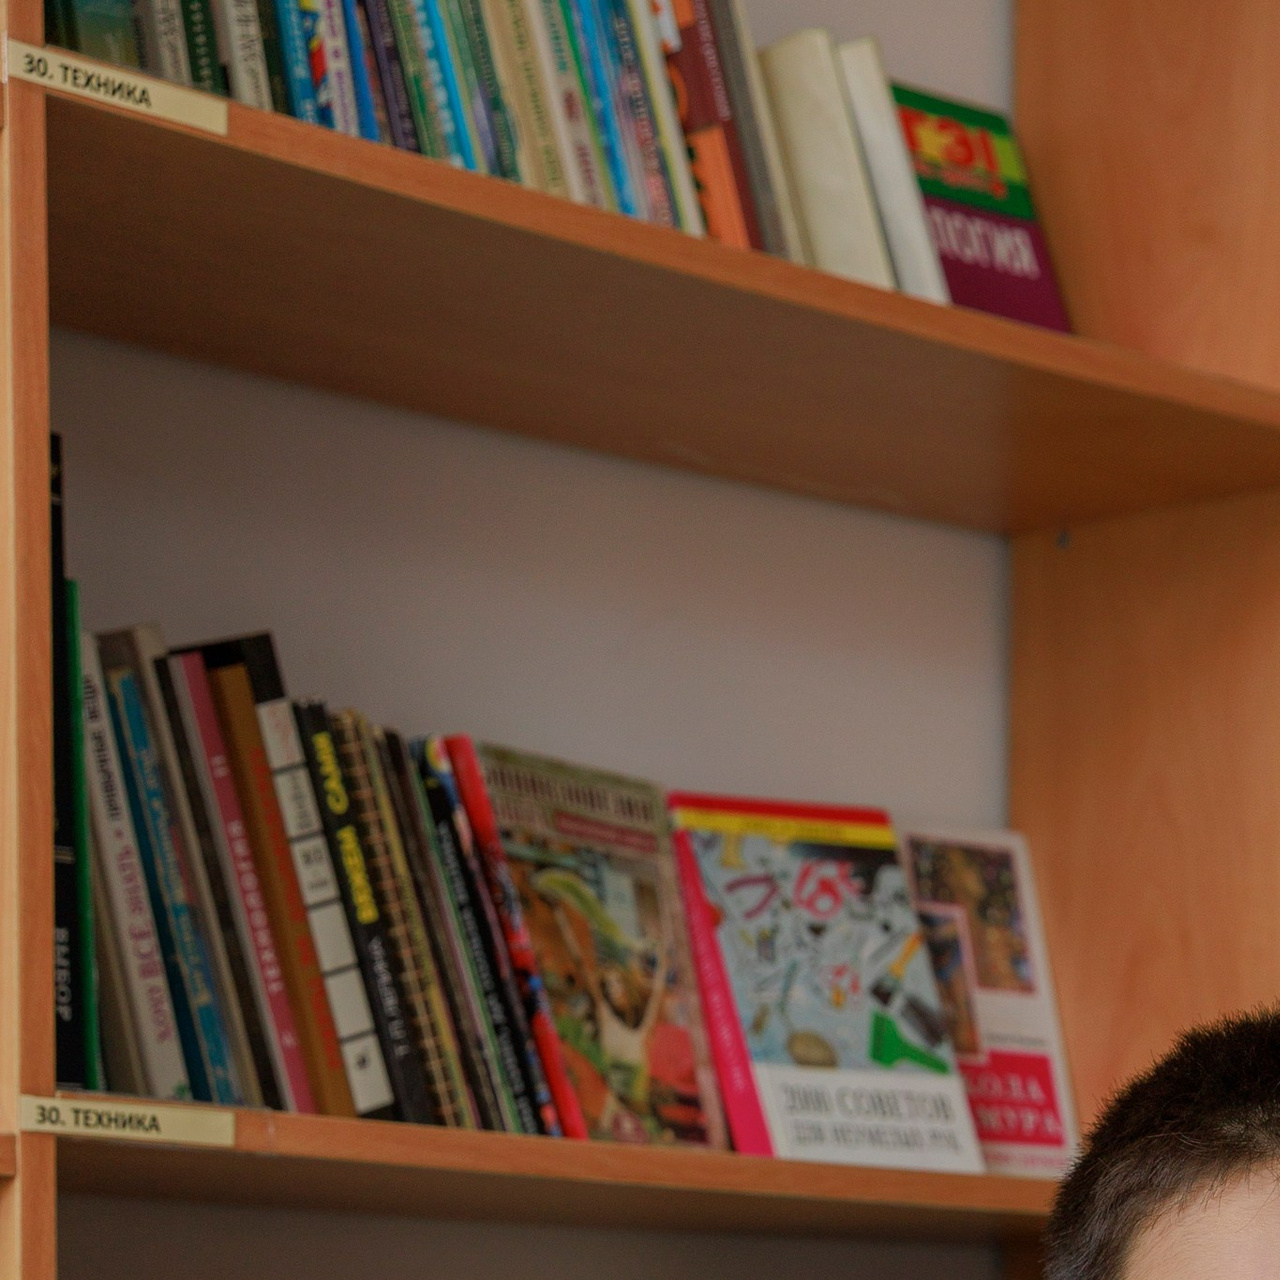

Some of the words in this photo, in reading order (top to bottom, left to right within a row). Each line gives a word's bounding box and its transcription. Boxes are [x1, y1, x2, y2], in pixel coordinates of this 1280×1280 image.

[22, 53, 54, 80] 30.
[59, 63, 152, 109] ТЕХНИКА
[36, 1106, 65, 1127] 30.
[73, 1107, 161, 1133] ТЕХНИКА
